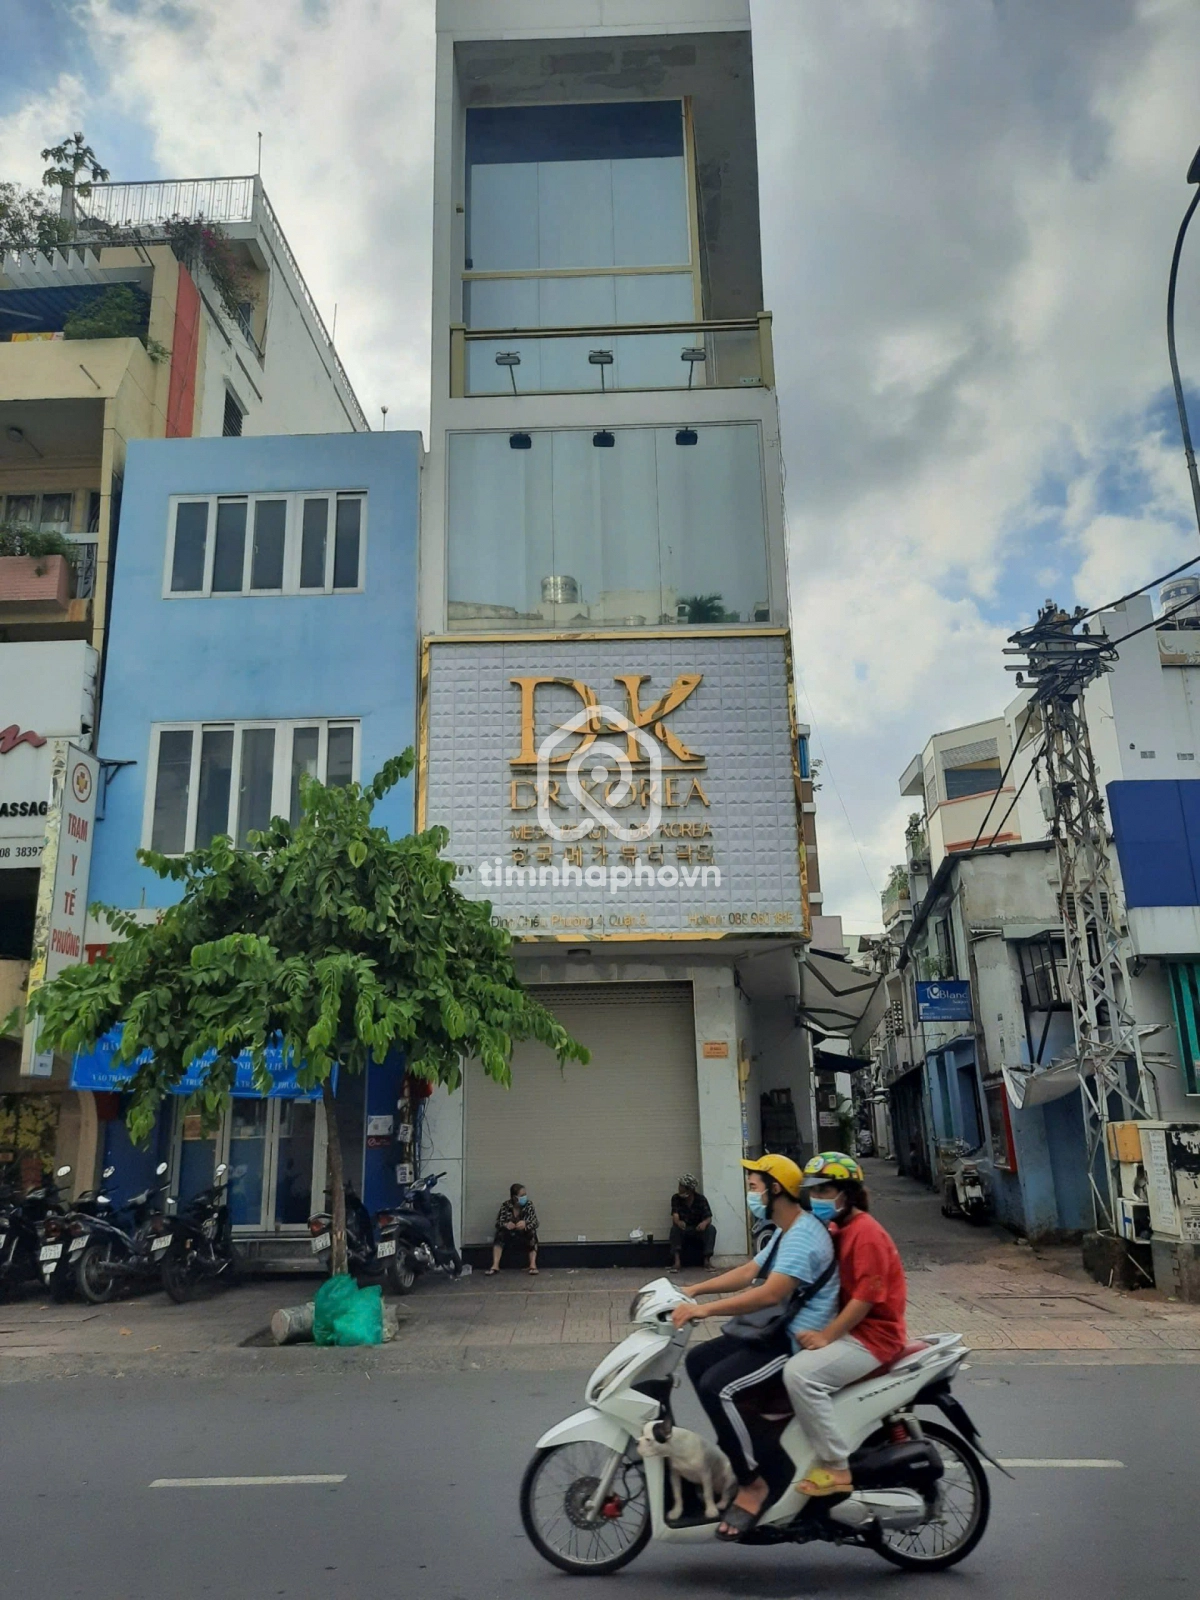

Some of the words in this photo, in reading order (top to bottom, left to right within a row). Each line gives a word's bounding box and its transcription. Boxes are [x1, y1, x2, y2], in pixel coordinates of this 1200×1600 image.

[510, 779, 569, 811] DR
[578, 776, 711, 810] KOREA
[67, 812, 88, 843] TRẠM
[628, 821, 652, 840] DR
[659, 821, 713, 839] KOREA
[71, 854, 78, 877] Y
[64, 887, 78, 916] TẾ
[51, 927, 81, 958] PHƯỜNG
